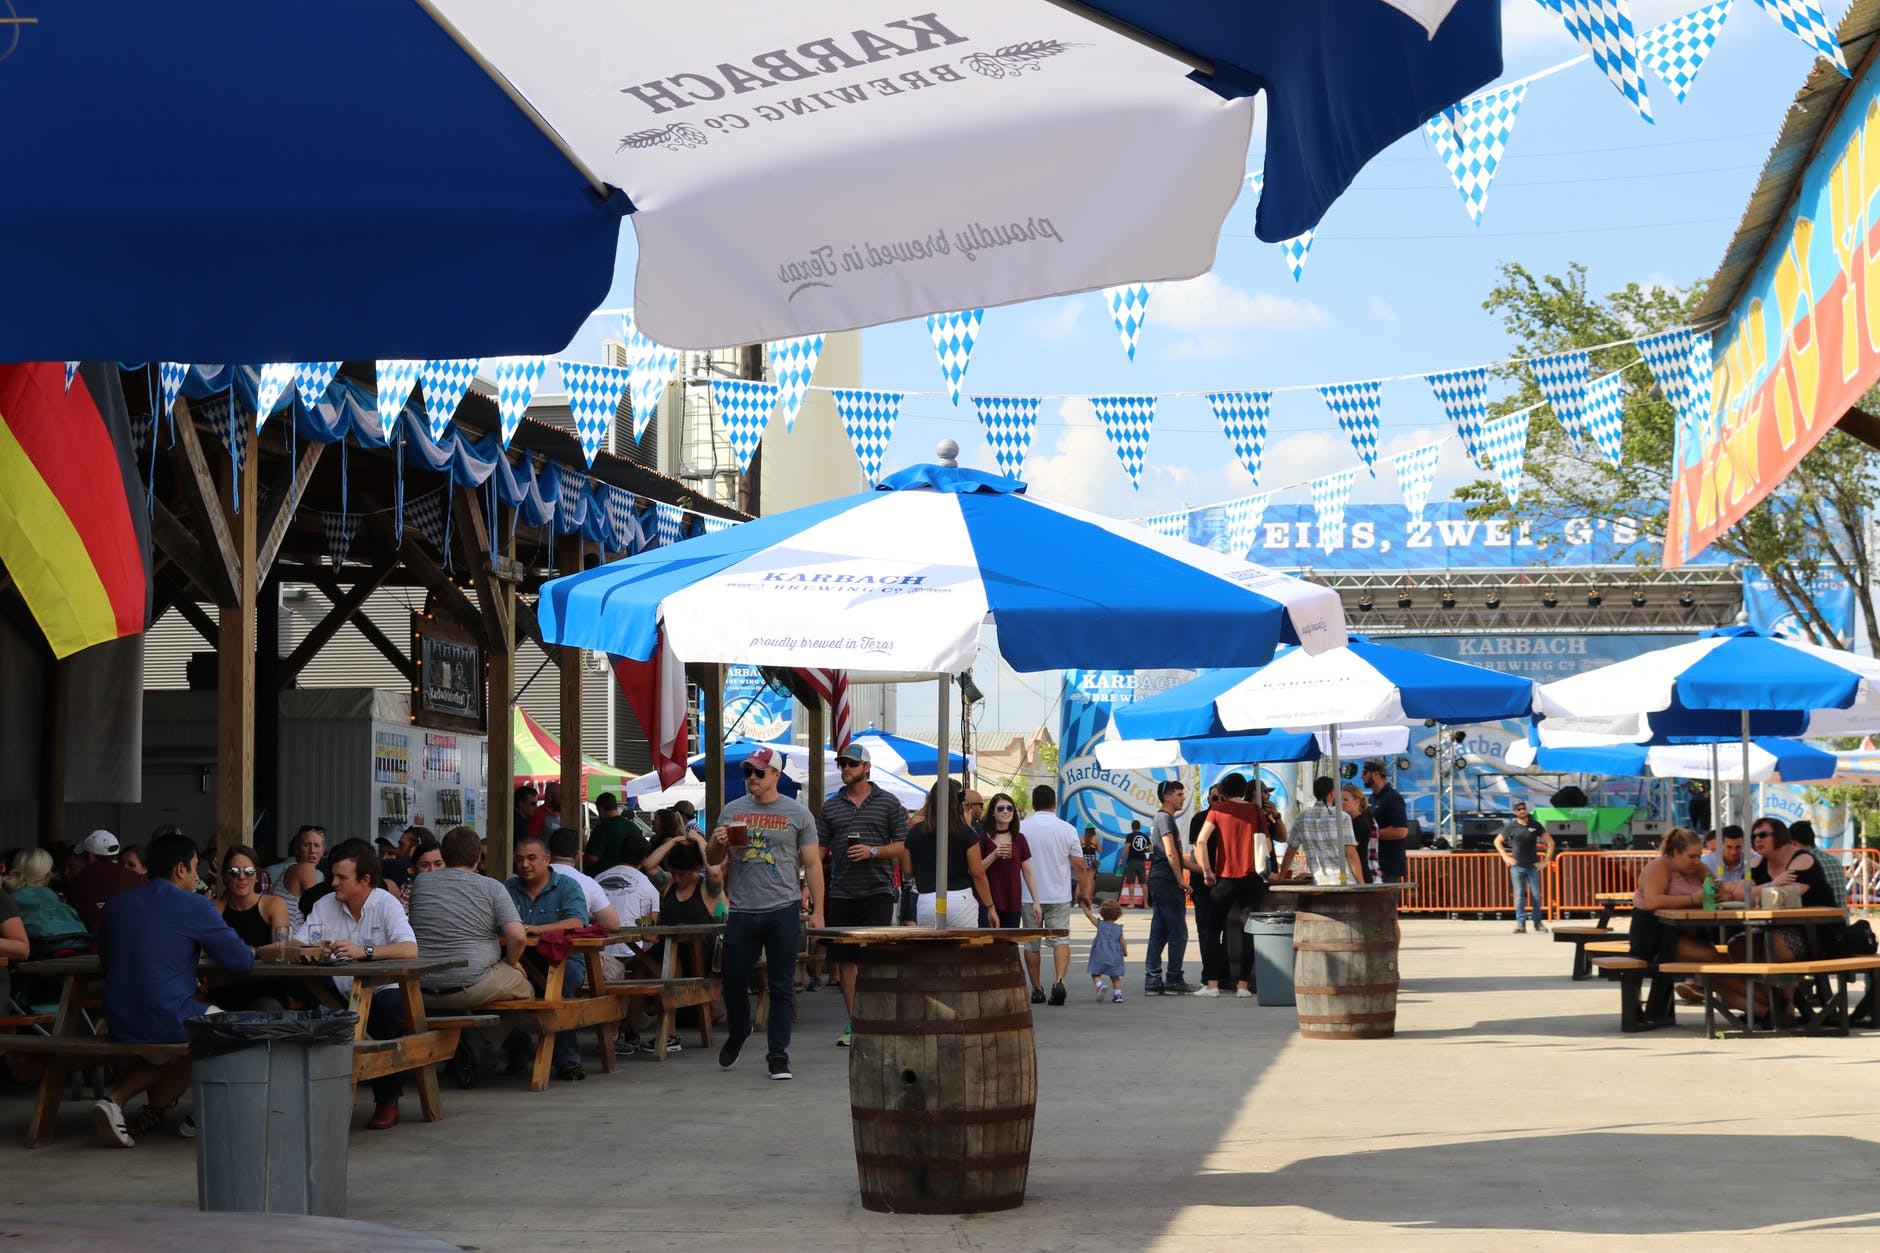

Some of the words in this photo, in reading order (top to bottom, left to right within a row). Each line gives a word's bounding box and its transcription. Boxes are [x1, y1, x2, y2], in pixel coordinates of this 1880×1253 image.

[762, 572, 927, 585] KARBACH
[774, 584, 873, 593] BREWING
[749, 636, 797, 648] proudly
[800, 636, 842, 649] brewed
[846, 637, 857, 649] in
[860, 636, 895, 650] Texas
[1458, 637, 1587, 655] KARBACH
[728, 669, 761, 677] ARBA
[1082, 674, 1181, 690] KARBACH
